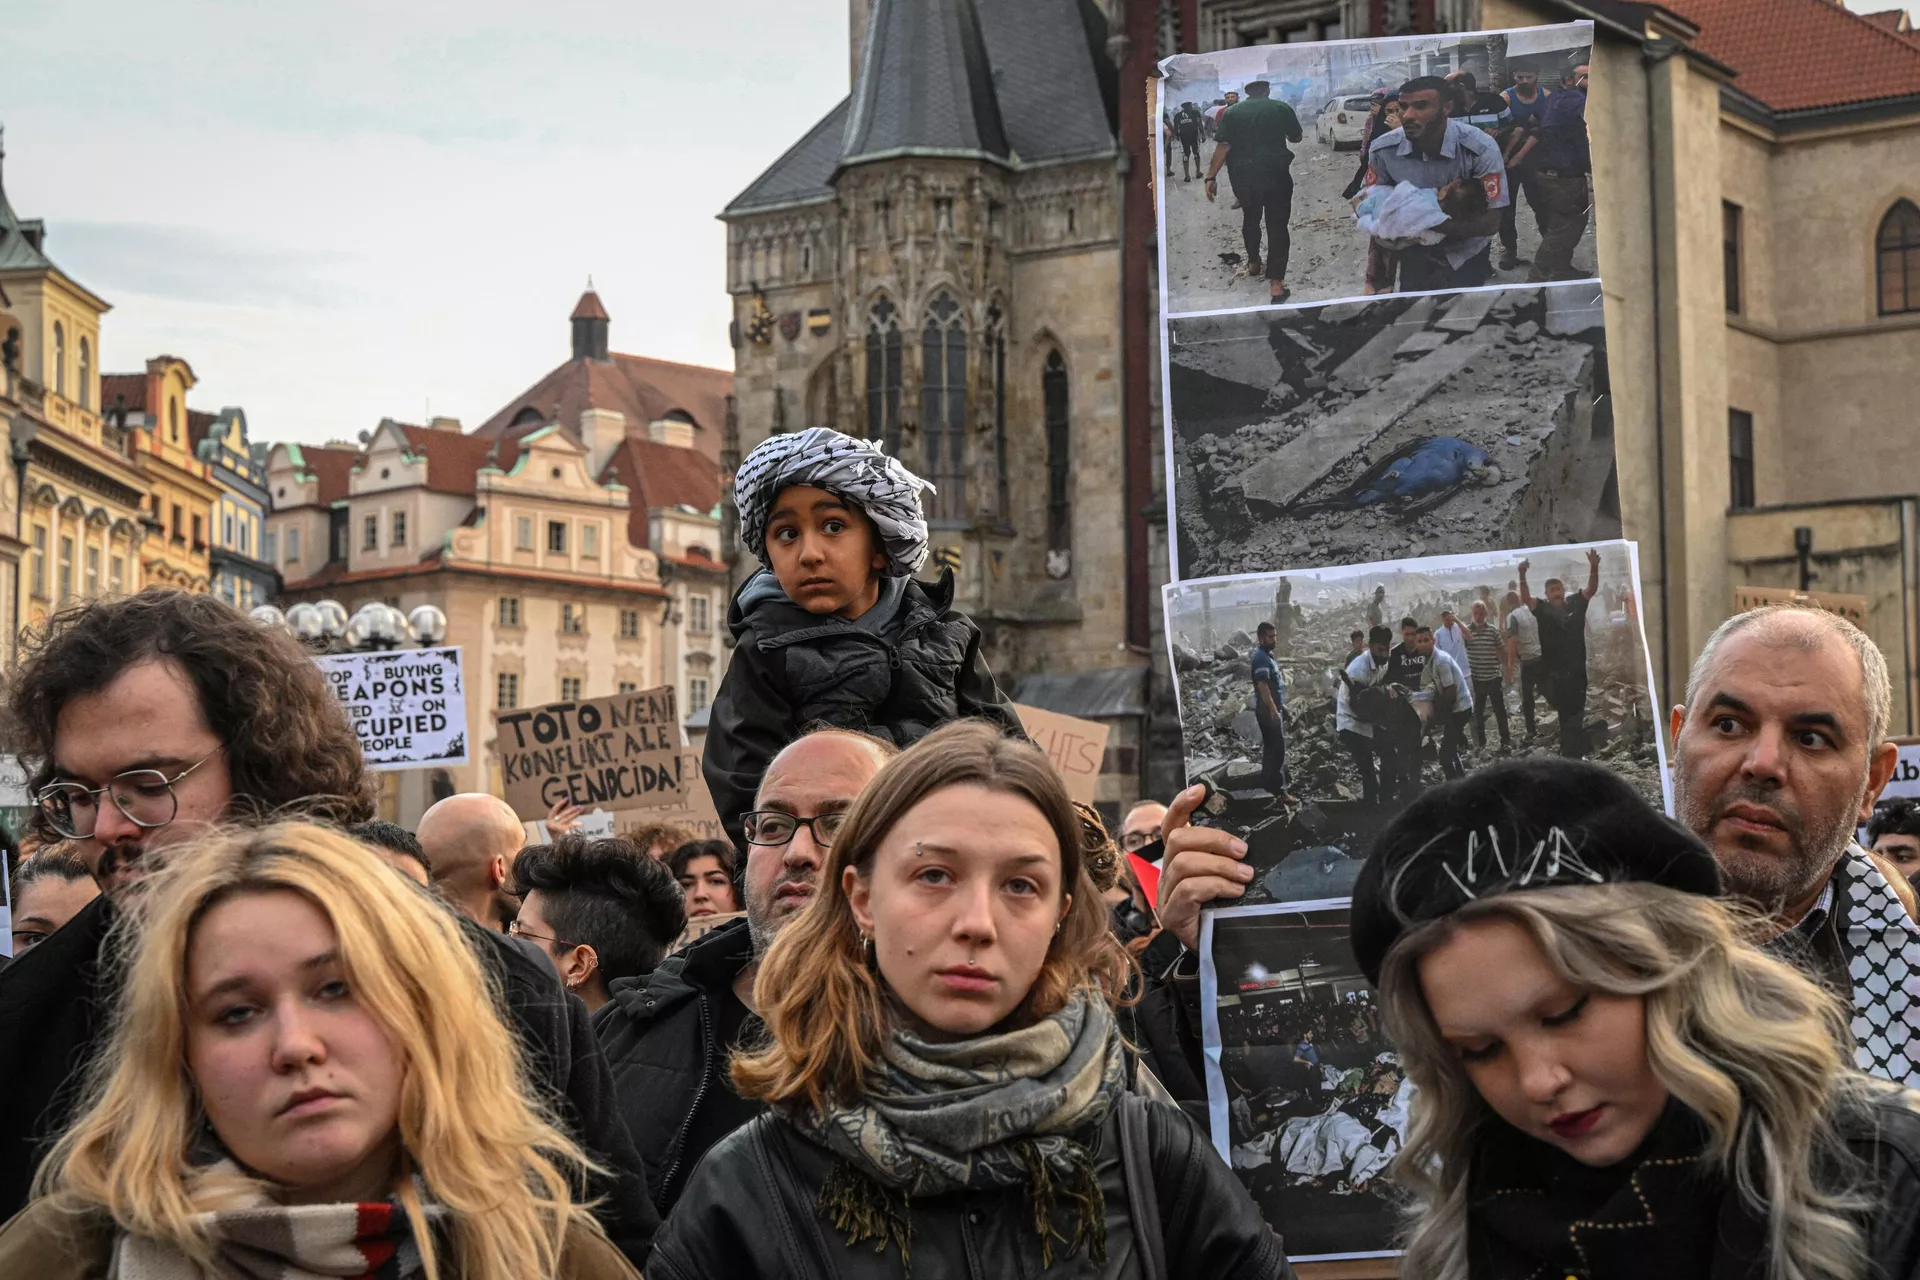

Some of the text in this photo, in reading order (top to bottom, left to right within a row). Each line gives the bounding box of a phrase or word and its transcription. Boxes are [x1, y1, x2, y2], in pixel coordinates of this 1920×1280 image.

[384, 663, 443, 680] BUYING
[336, 677, 445, 701] EAPONS
[422, 699, 446, 712] ON
[354, 714, 447, 738] CUPIED
[498, 703, 602, 748] TOTO
[624, 726, 671, 757] ALE
[541, 755, 681, 810] GENOCIDA!
